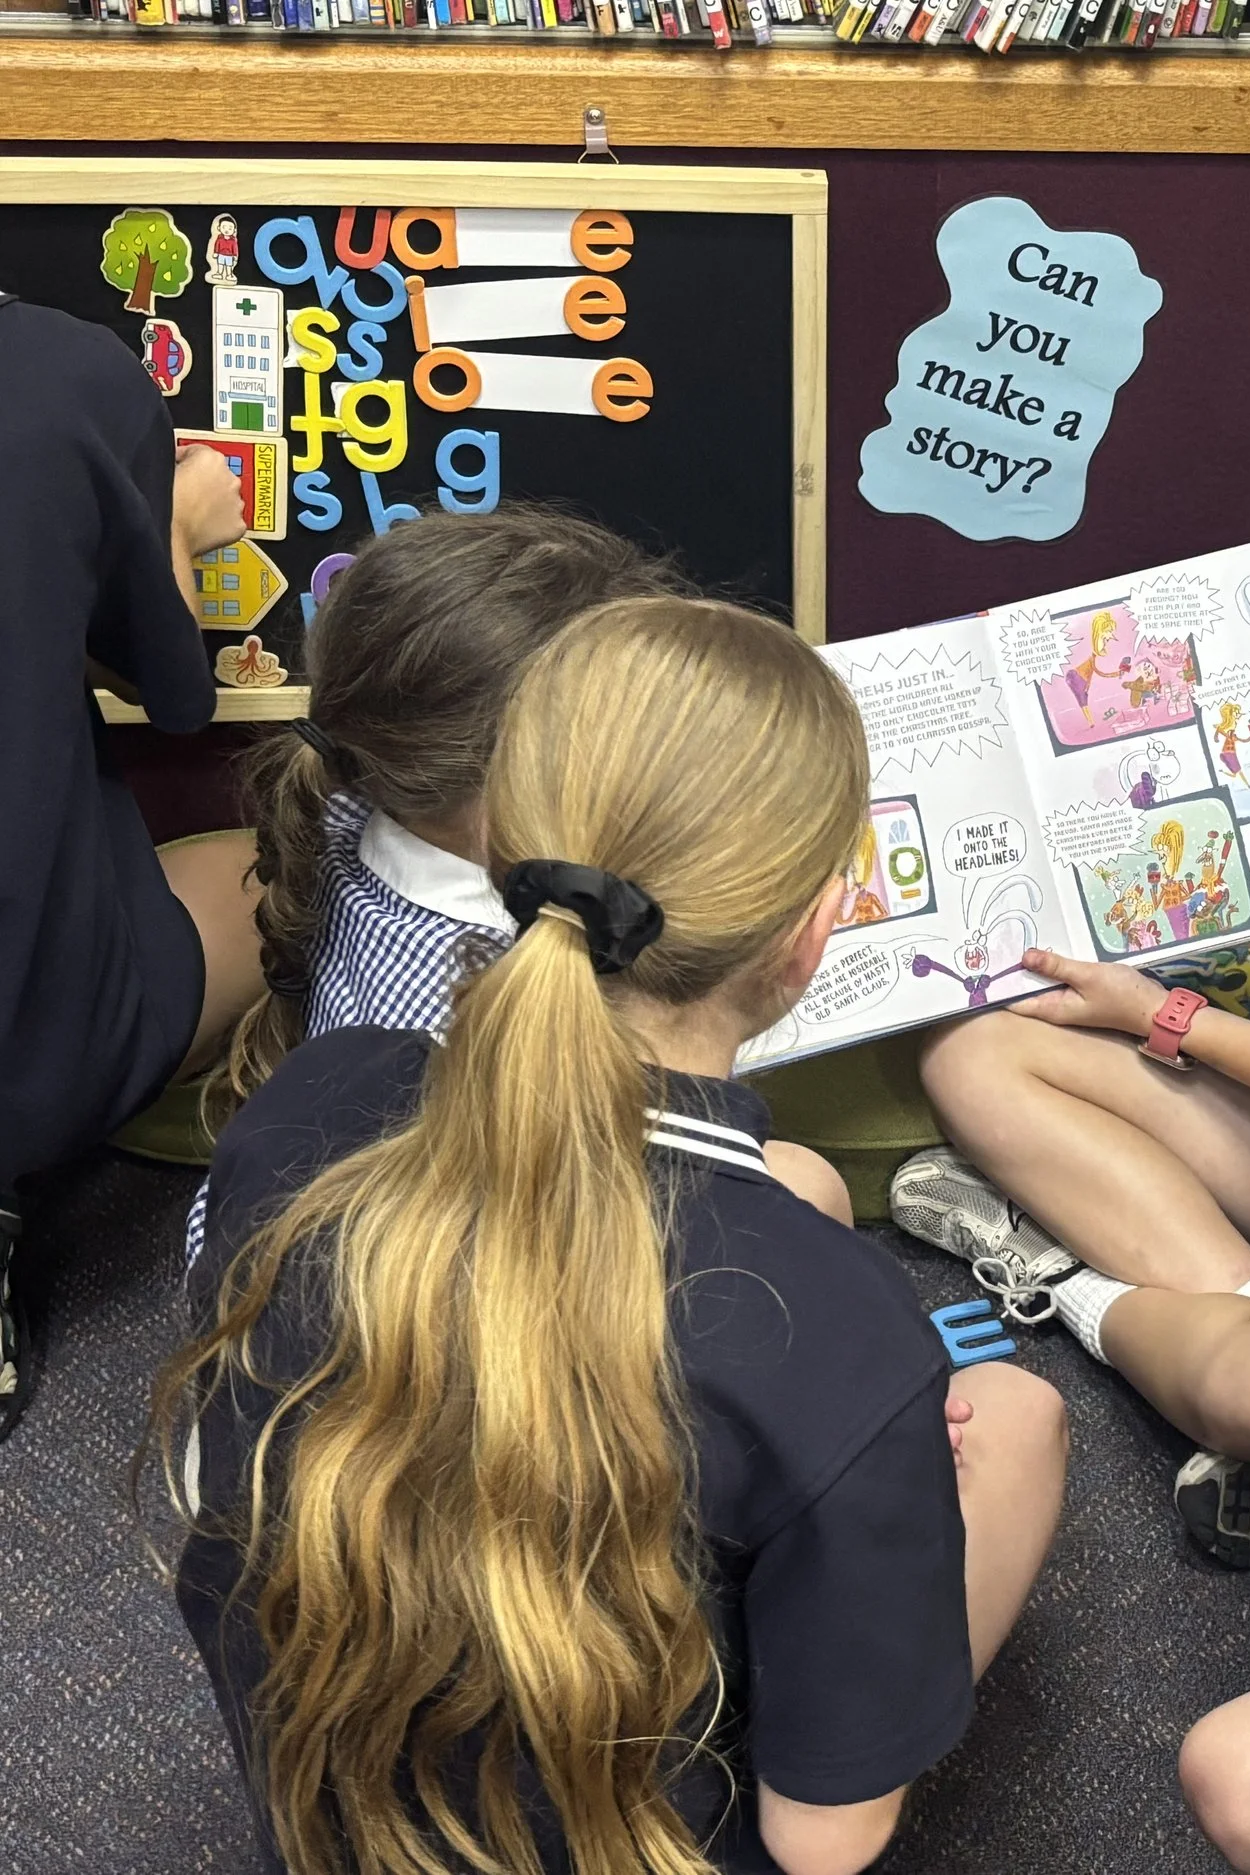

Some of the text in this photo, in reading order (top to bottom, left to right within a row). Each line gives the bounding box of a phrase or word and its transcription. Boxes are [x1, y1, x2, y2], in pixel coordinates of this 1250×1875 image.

[390, 208, 460, 270] a
[570, 209, 634, 272] e
[1007, 242, 1100, 307] Can
[405, 275, 627, 352] i e
[291, 306, 341, 373] s
[337, 320, 387, 381] s
[975, 311, 1071, 366] you
[232, 379, 266, 394] HOSPITAL
[591, 357, 654, 422] e
[916, 360, 1083, 442] make a
[340, 380, 408, 473] g
[435, 428, 500, 514] g
[906, 426, 1052, 494] story?
[256, 445, 273, 529] SUPERMARKET
[293, 471, 342, 531] s
[1012, 634, 1055, 649] YOU UPSET
[1035, 643, 1057, 654] YOUR
[1015, 652, 1061, 668] CHOCOLATE
[854, 672, 928, 699] NEWS JUST
[883, 698, 894, 706] OF
[896, 687, 938, 702] CHILDREN
[940, 683, 954, 691] ALL
[883, 699, 977, 727] ONLY CHOCOLATE TOYS
[889, 702, 918, 715] WORLD
[920, 696, 943, 707] HAVE
[945, 690, 972, 702] WOKEN
[884, 740, 894, 749] TO
[897, 735, 914, 745] YOU
[917, 725, 956, 741] CLARISSA
[900, 715, 949, 735] CHRISTMAS
[957, 821, 1009, 841] I MADE IT
[963, 837, 1008, 854] ONTO THE
[955, 849, 1020, 871] HEADLINES!
[804, 1001, 822, 1014] ALL
[822, 983, 853, 1005] BECAUSE
[864, 961, 891, 983] NASTY
[834, 974, 847, 986] ARE
[815, 994, 860, 1021] OLD SANTA
